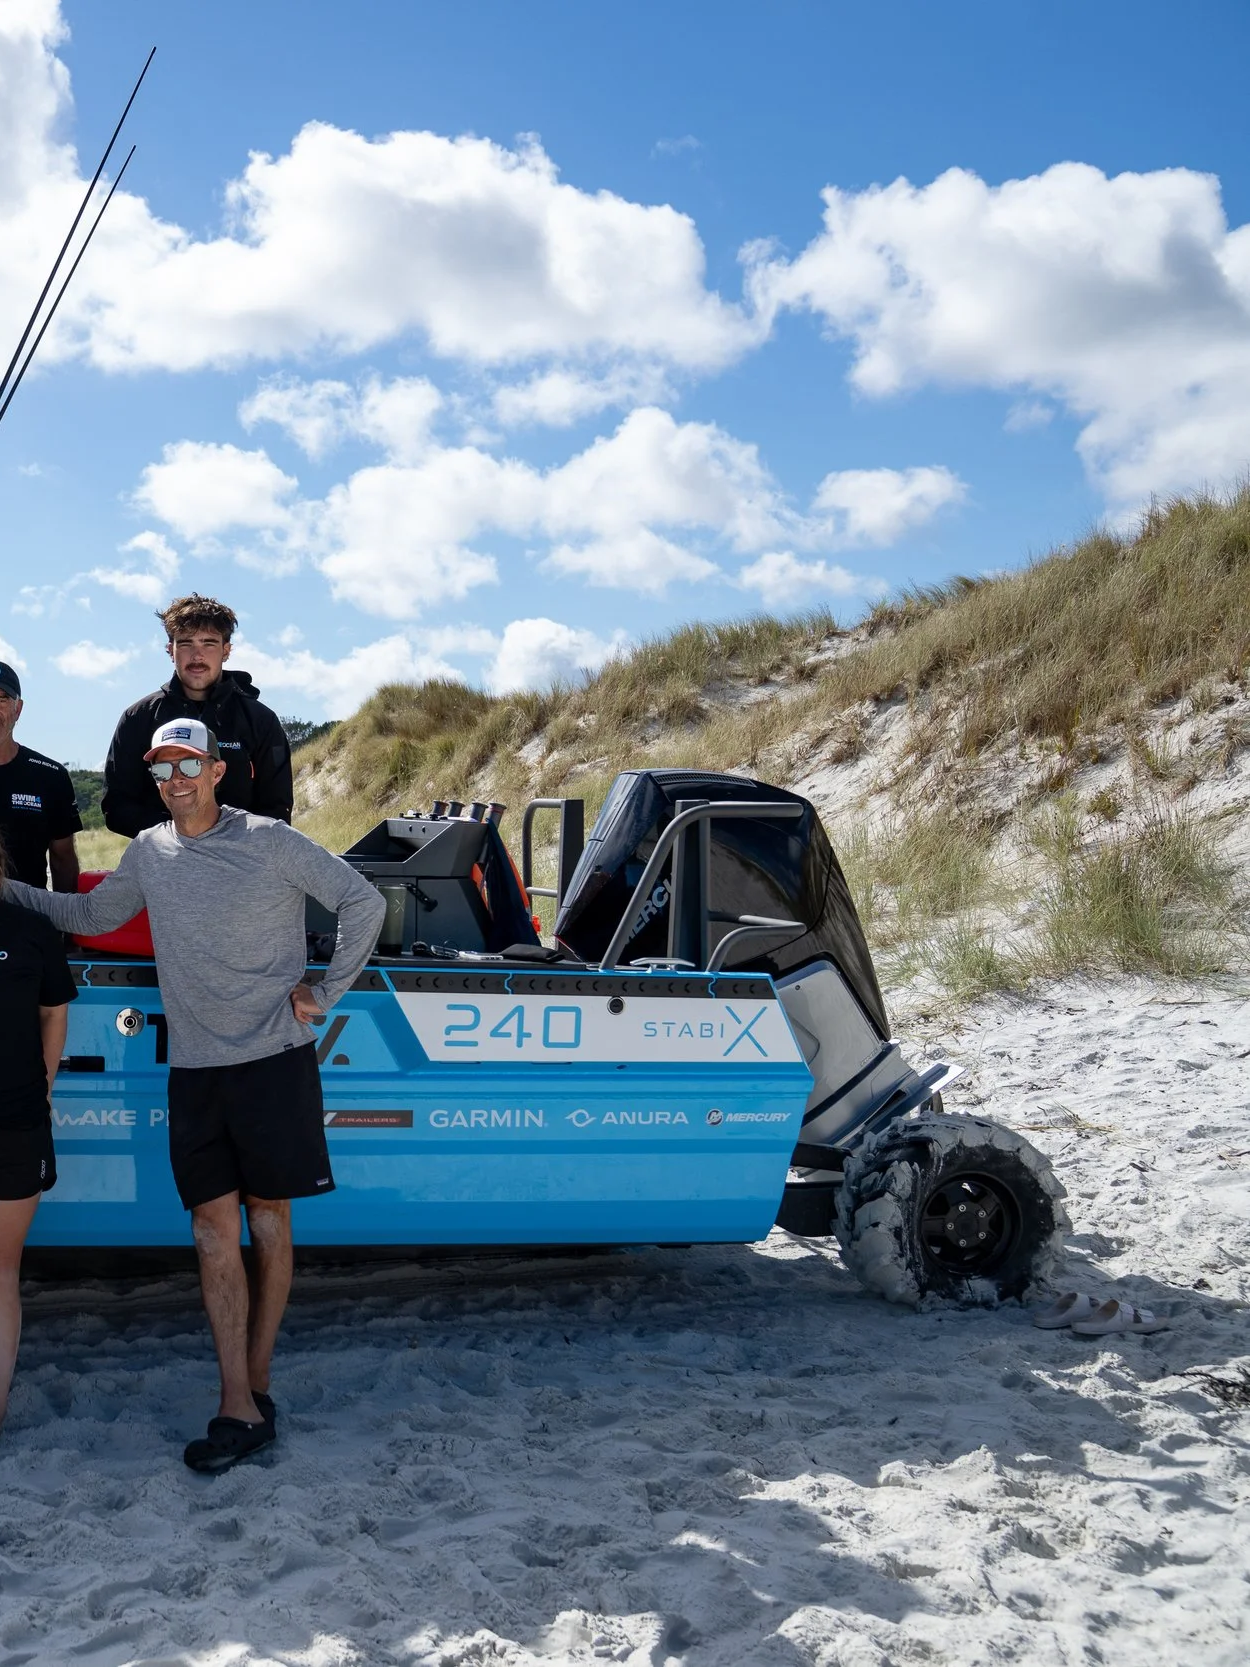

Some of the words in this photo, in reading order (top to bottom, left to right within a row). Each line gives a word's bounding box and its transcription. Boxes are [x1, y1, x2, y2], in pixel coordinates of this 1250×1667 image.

[42, 761, 59, 771] RIDLER
[444, 1004, 581, 1048] 240
[150, 1109, 169, 1127] P
[429, 1109, 543, 1128] GARMIN
[602, 1111, 689, 1124] ANURA
[725, 1113, 791, 1122] MERCURY
